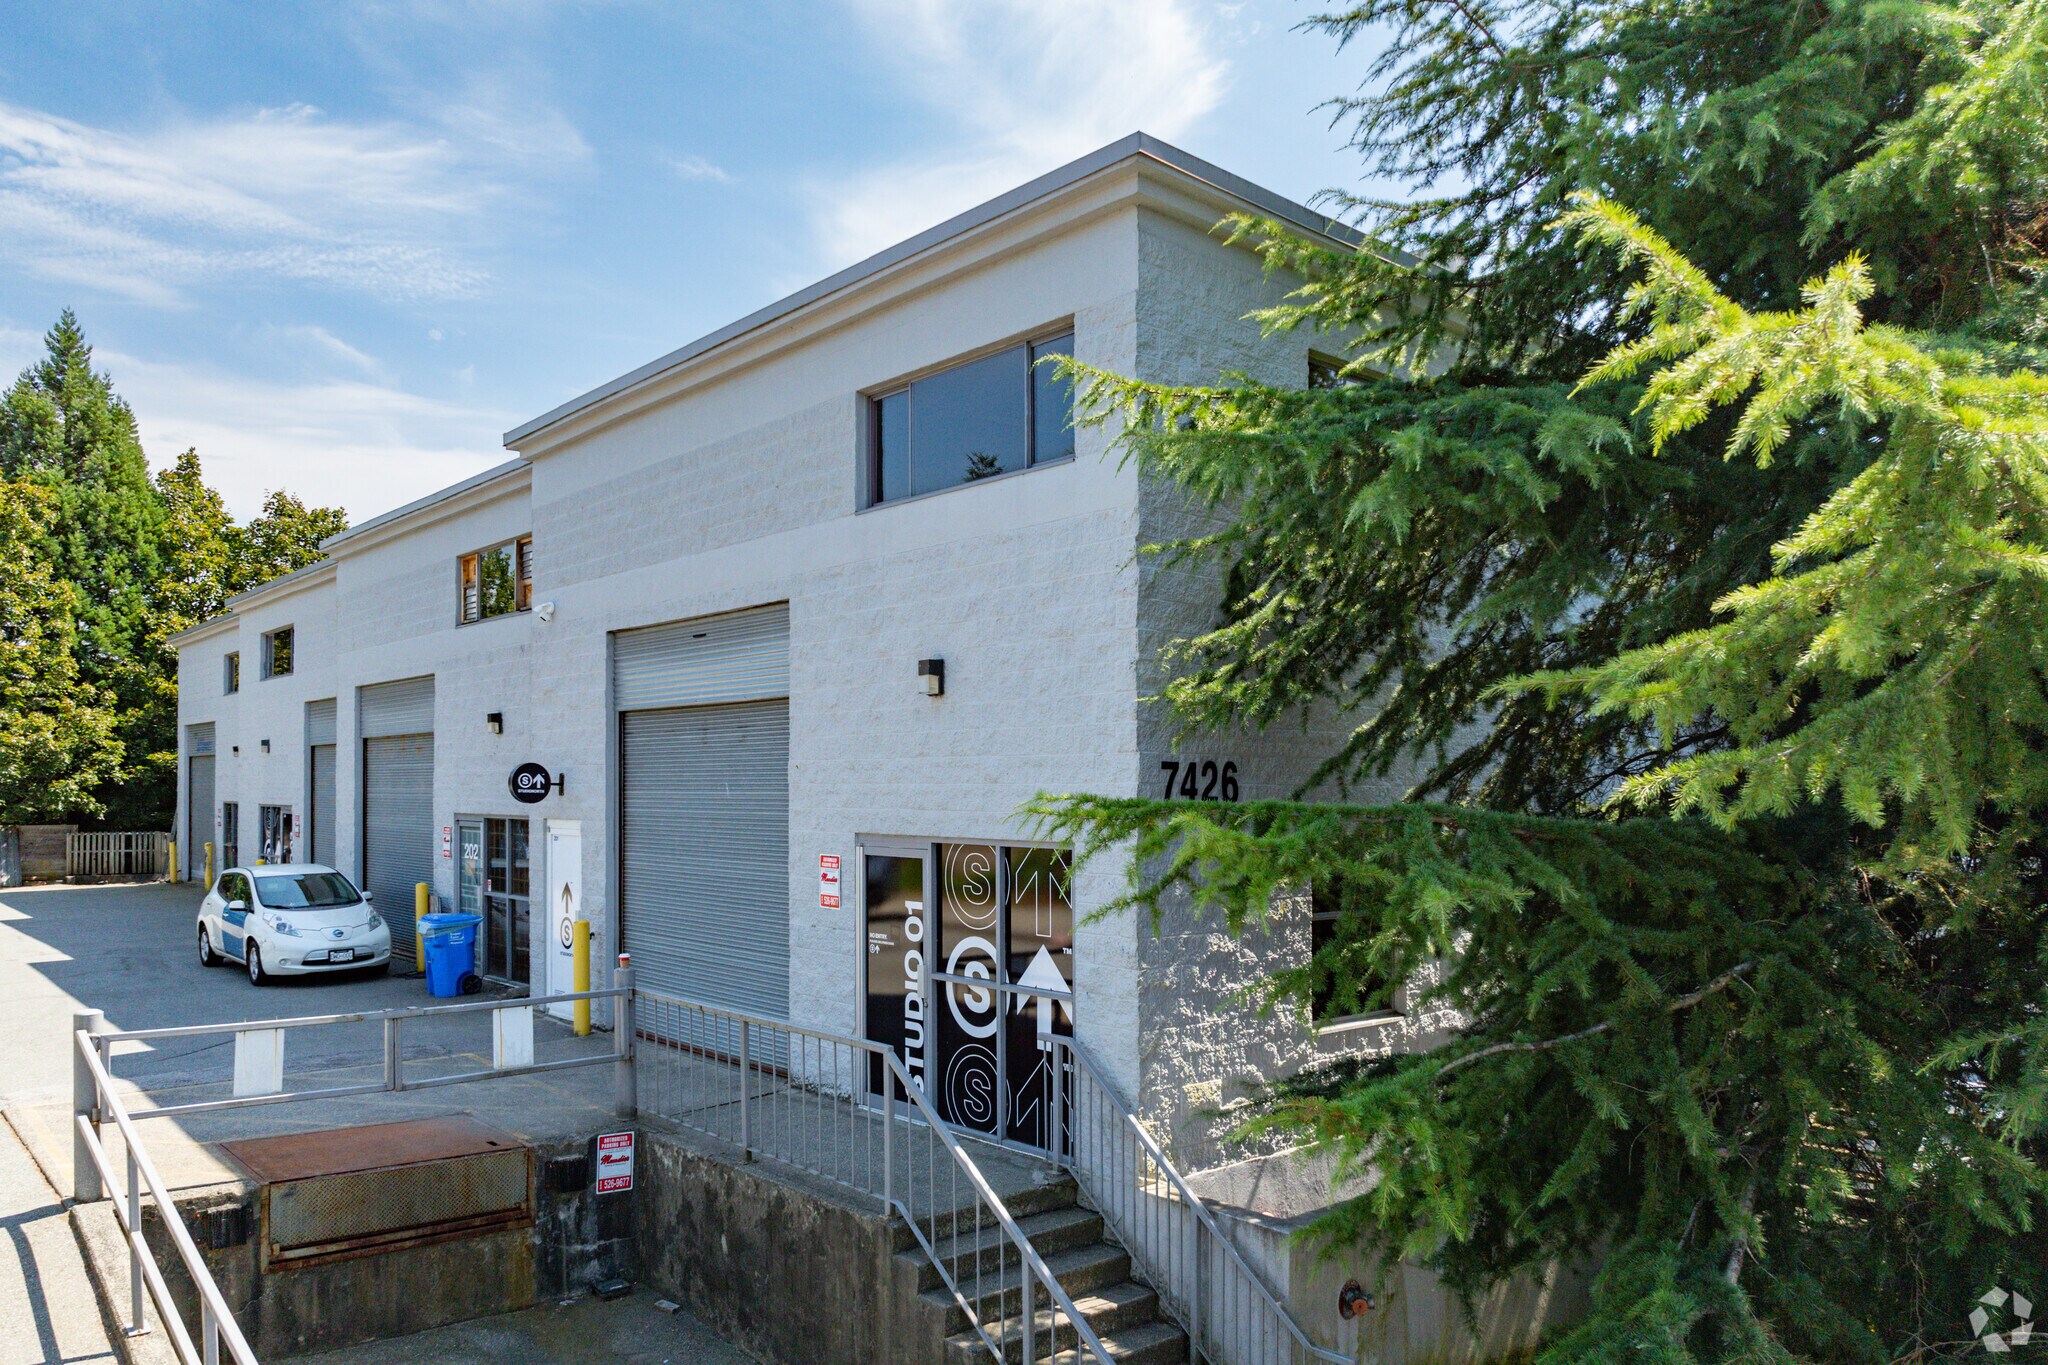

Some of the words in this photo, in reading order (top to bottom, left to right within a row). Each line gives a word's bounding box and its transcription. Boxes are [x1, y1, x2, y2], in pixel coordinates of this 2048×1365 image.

[1161, 760, 1239, 802] 7426
[464, 843, 479, 860] 202
[604, 1177, 630, 1189] 526-9677
